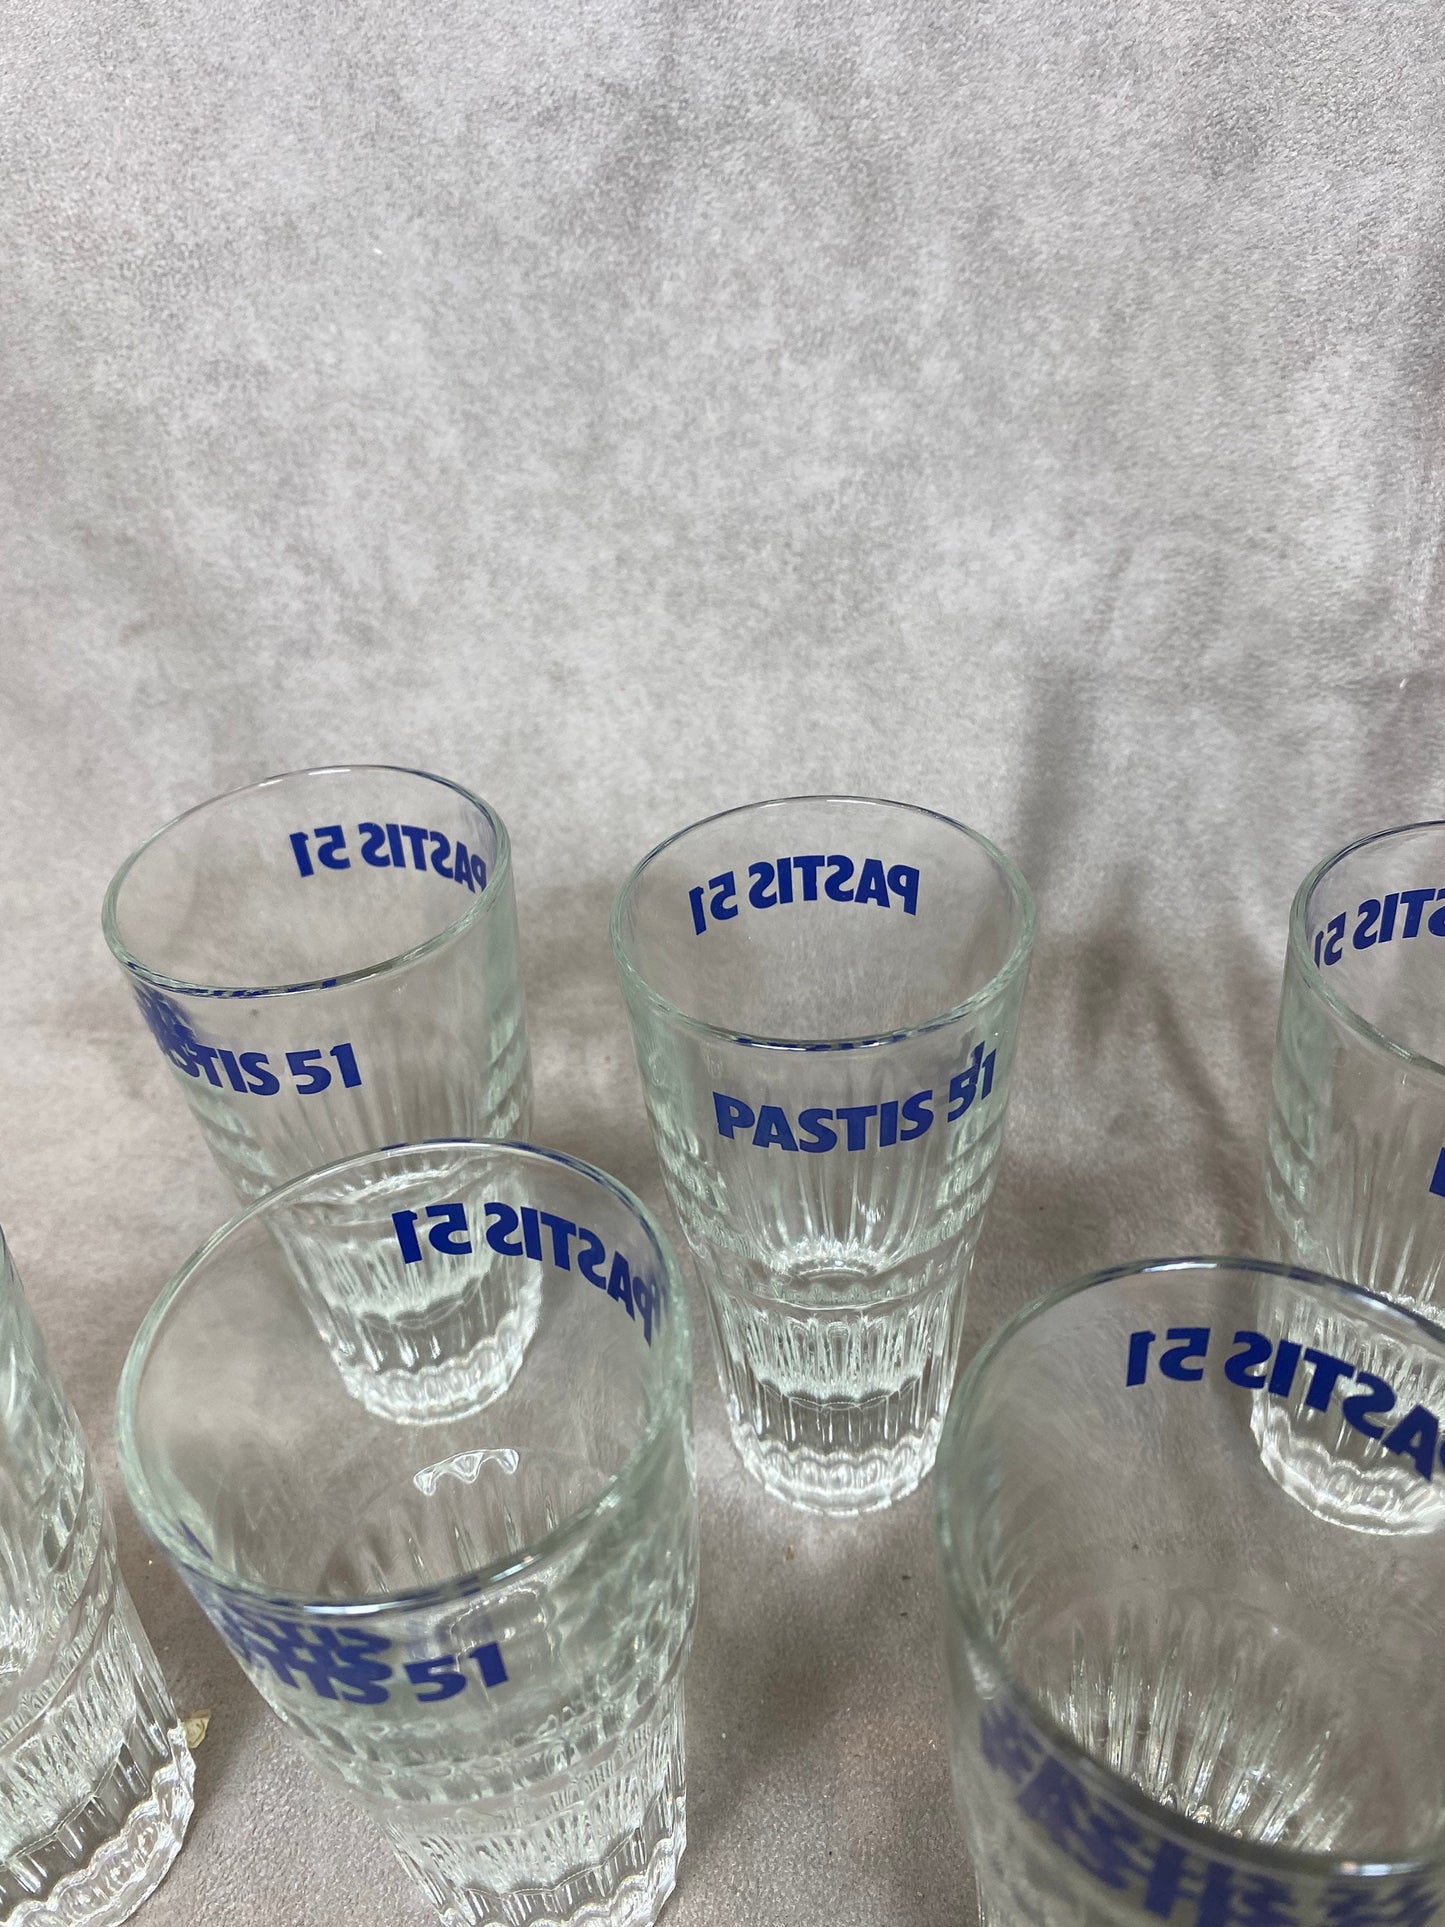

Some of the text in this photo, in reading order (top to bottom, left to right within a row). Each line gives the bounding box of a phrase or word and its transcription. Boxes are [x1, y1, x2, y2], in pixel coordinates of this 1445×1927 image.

[284, 1042, 363, 1096] 51
[712, 1045, 997, 1154] PASTIS 51
[403, 1640, 509, 1703] 51
